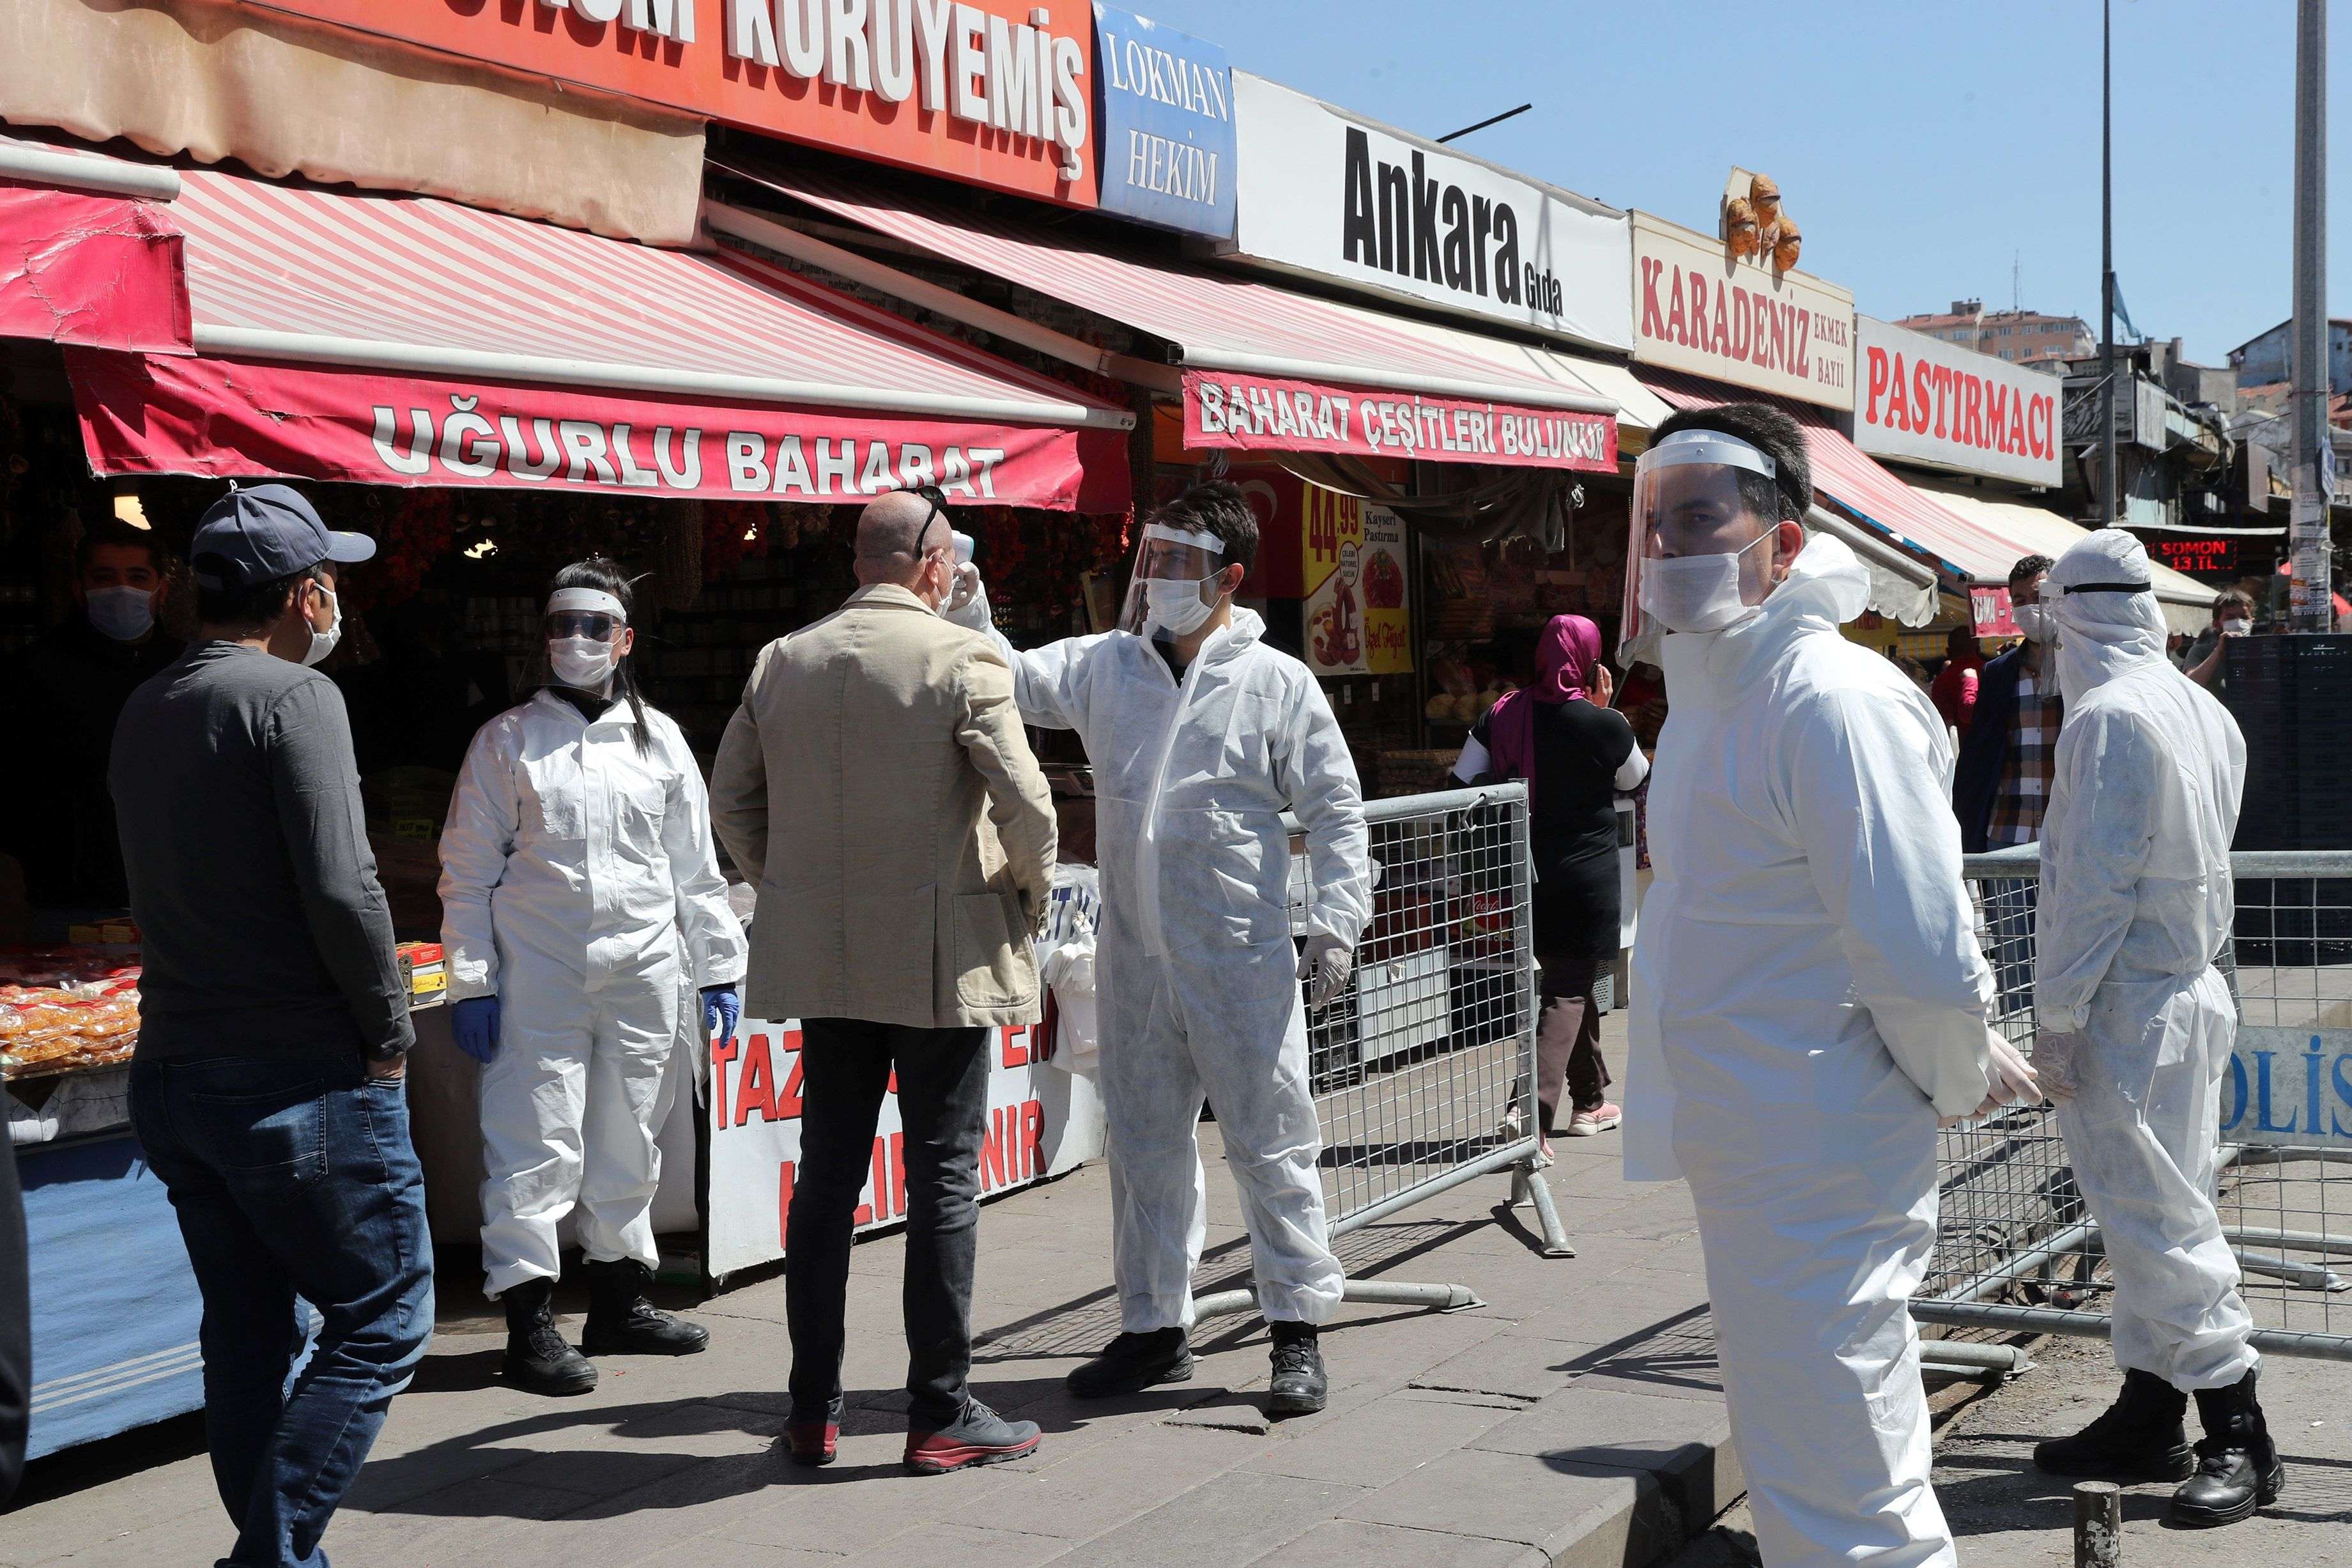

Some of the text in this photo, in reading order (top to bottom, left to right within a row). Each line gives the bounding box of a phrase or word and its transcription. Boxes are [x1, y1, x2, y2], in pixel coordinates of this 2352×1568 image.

[1106, 32, 1228, 122] LOKMAN
[1126, 130, 1217, 206] HEKİM
[1343, 126, 1521, 305] Ankara
[1641, 256, 1810, 380] KARADENİZ
[1814, 312, 1847, 348] EKMEK
[1200, 382, 1350, 442] BAHARAT
[1360, 394, 1496, 457] ÇEŞİTLERİ
[1866, 346, 2054, 461] PASTIRMACI
[371, 395, 1004, 498] UĞURLU BAHARAT
[1364, 527, 1399, 543] Pastırma
[1365, 511, 1396, 528] Kayseri
[2161, 541, 2226, 555] SOMON
[2196, 557, 2218, 571] TL
